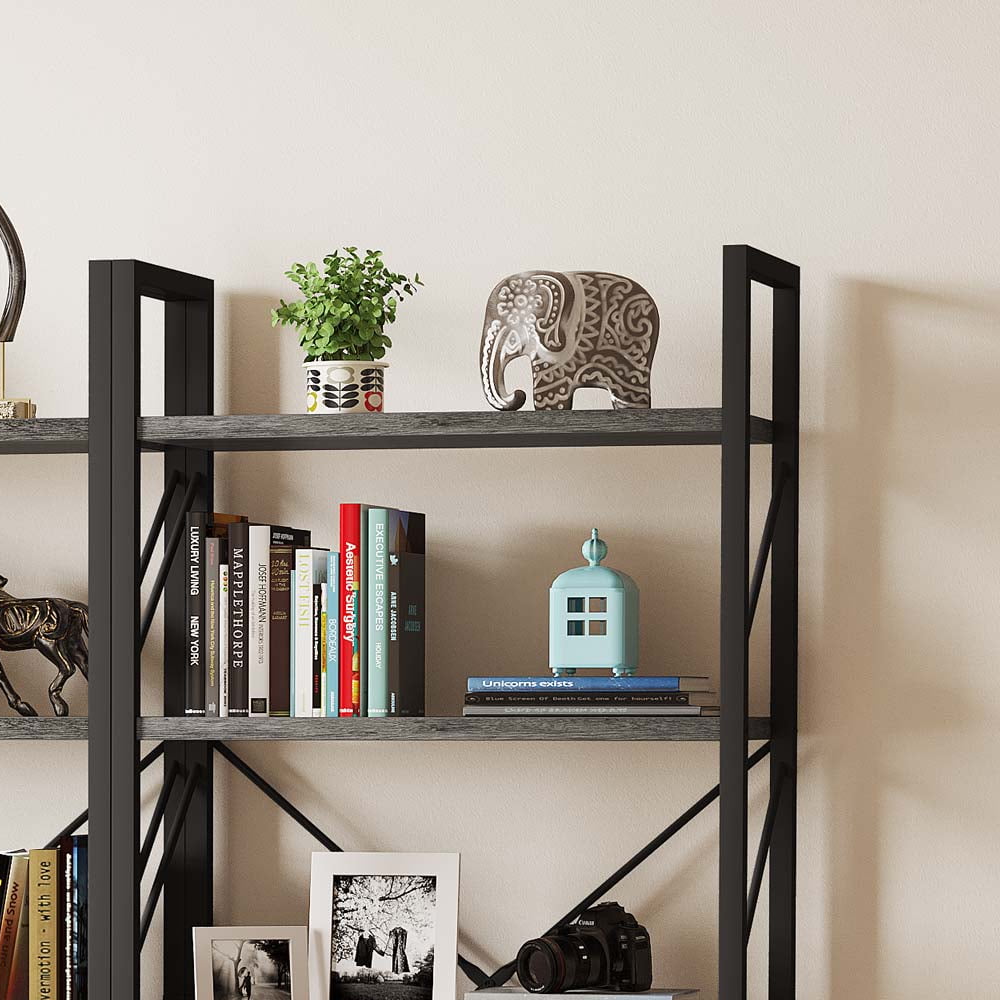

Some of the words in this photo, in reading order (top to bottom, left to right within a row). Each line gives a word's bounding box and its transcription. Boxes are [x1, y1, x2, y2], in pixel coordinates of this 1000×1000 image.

[190, 526, 199, 565] LUXURY
[375, 523, 384, 580] EXECUTIVE
[190, 565, 199, 595] LIVING
[258, 563, 267, 583] JOSEF
[298, 554, 310, 590] LOST
[232, 548, 243, 668] MAPPLETHORPE
[258, 584, 267, 623] HOFFMANN
[298, 595, 310, 627] FISH
[375, 584, 384, 631] ESCAPES
[190, 616, 199, 638] NEW
[329, 618, 337, 662] BORDEAUX
[190, 639, 199, 666] YORK
[482, 680, 537, 688] Unicorns
[540, 680, 574, 688] exists
[38, 861, 51, 886] love
[38, 895, 51, 922] with
